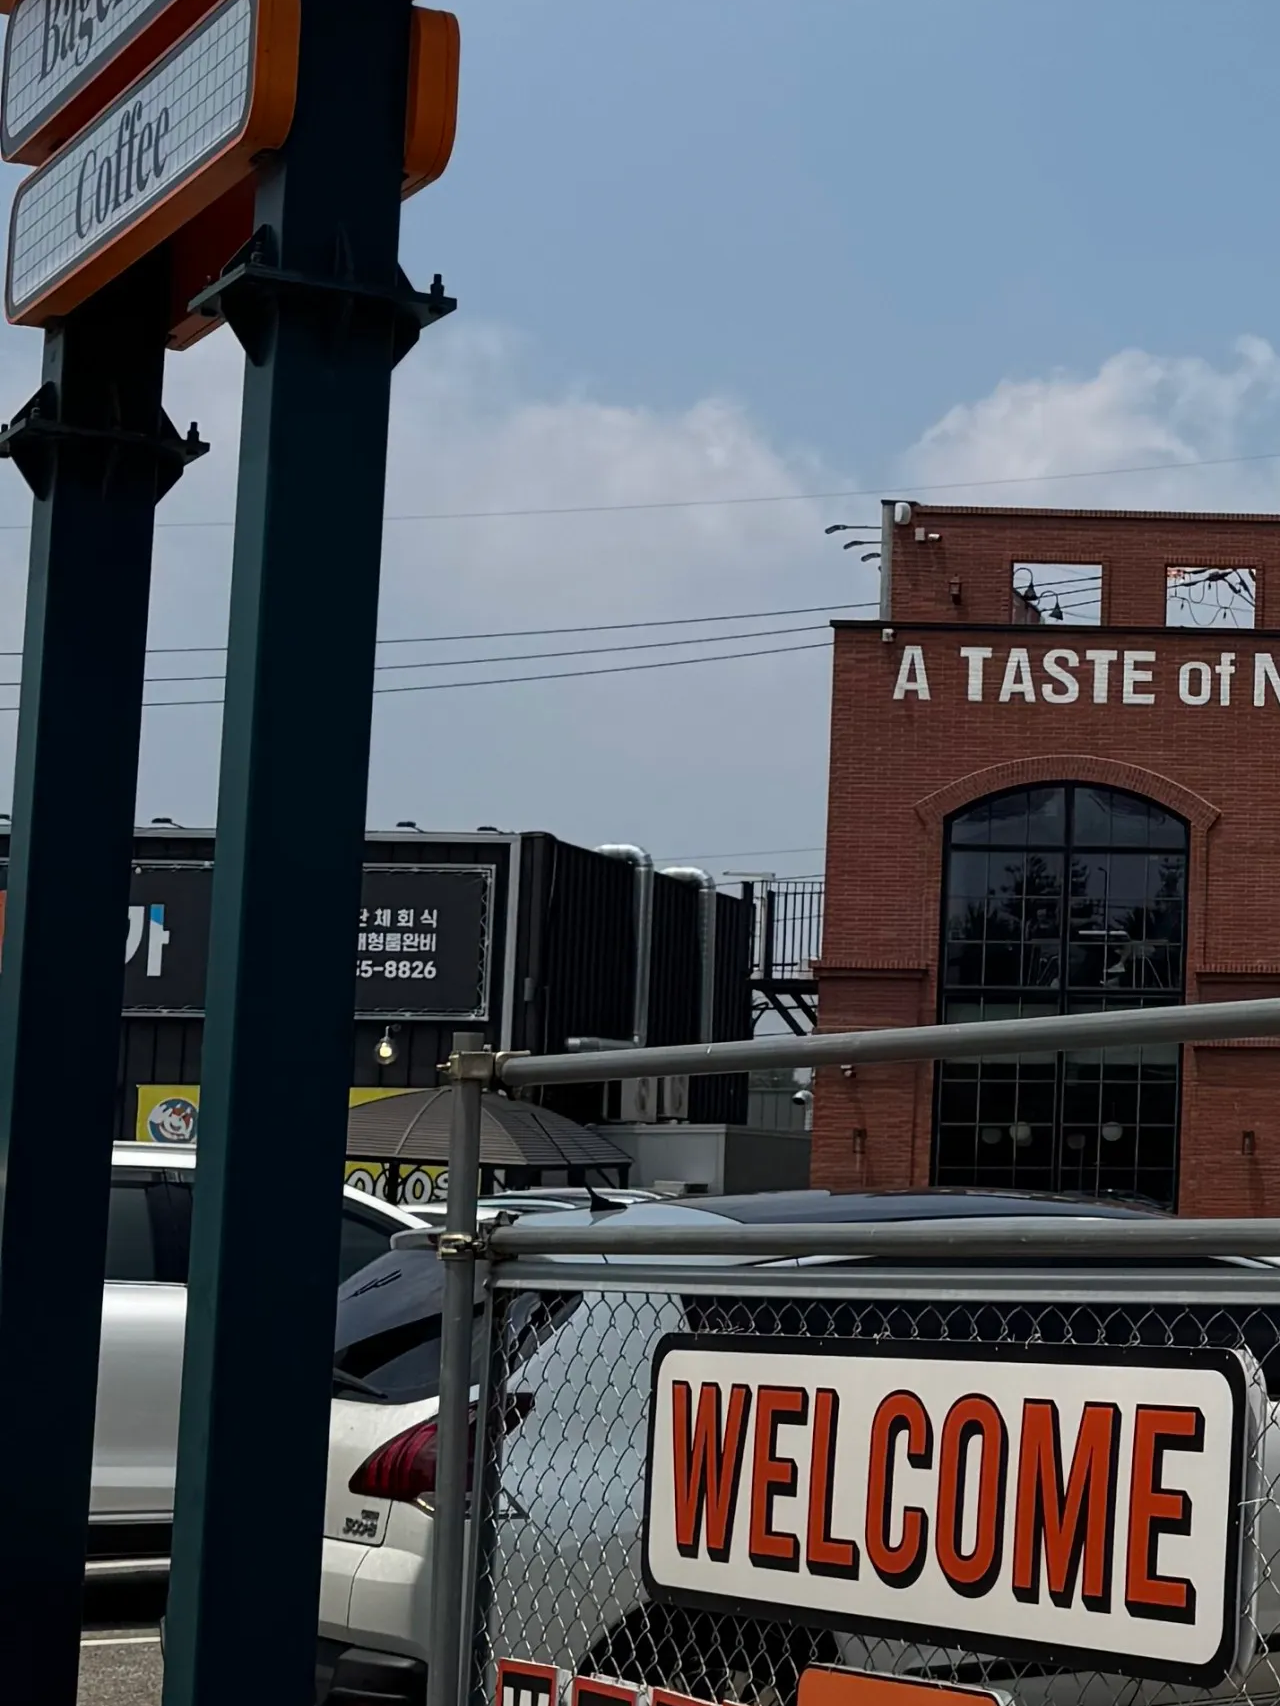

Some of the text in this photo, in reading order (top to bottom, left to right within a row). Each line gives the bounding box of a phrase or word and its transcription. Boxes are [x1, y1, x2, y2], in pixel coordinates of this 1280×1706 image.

[74, 99, 171, 241] Coffee
[893, 645, 932, 701] A
[960, 646, 1156, 706] TASTE
[1178, 651, 1233, 707] of
[356, 960, 437, 979] 5-8826
[671, 1380, 1206, 1626] WELCOME
